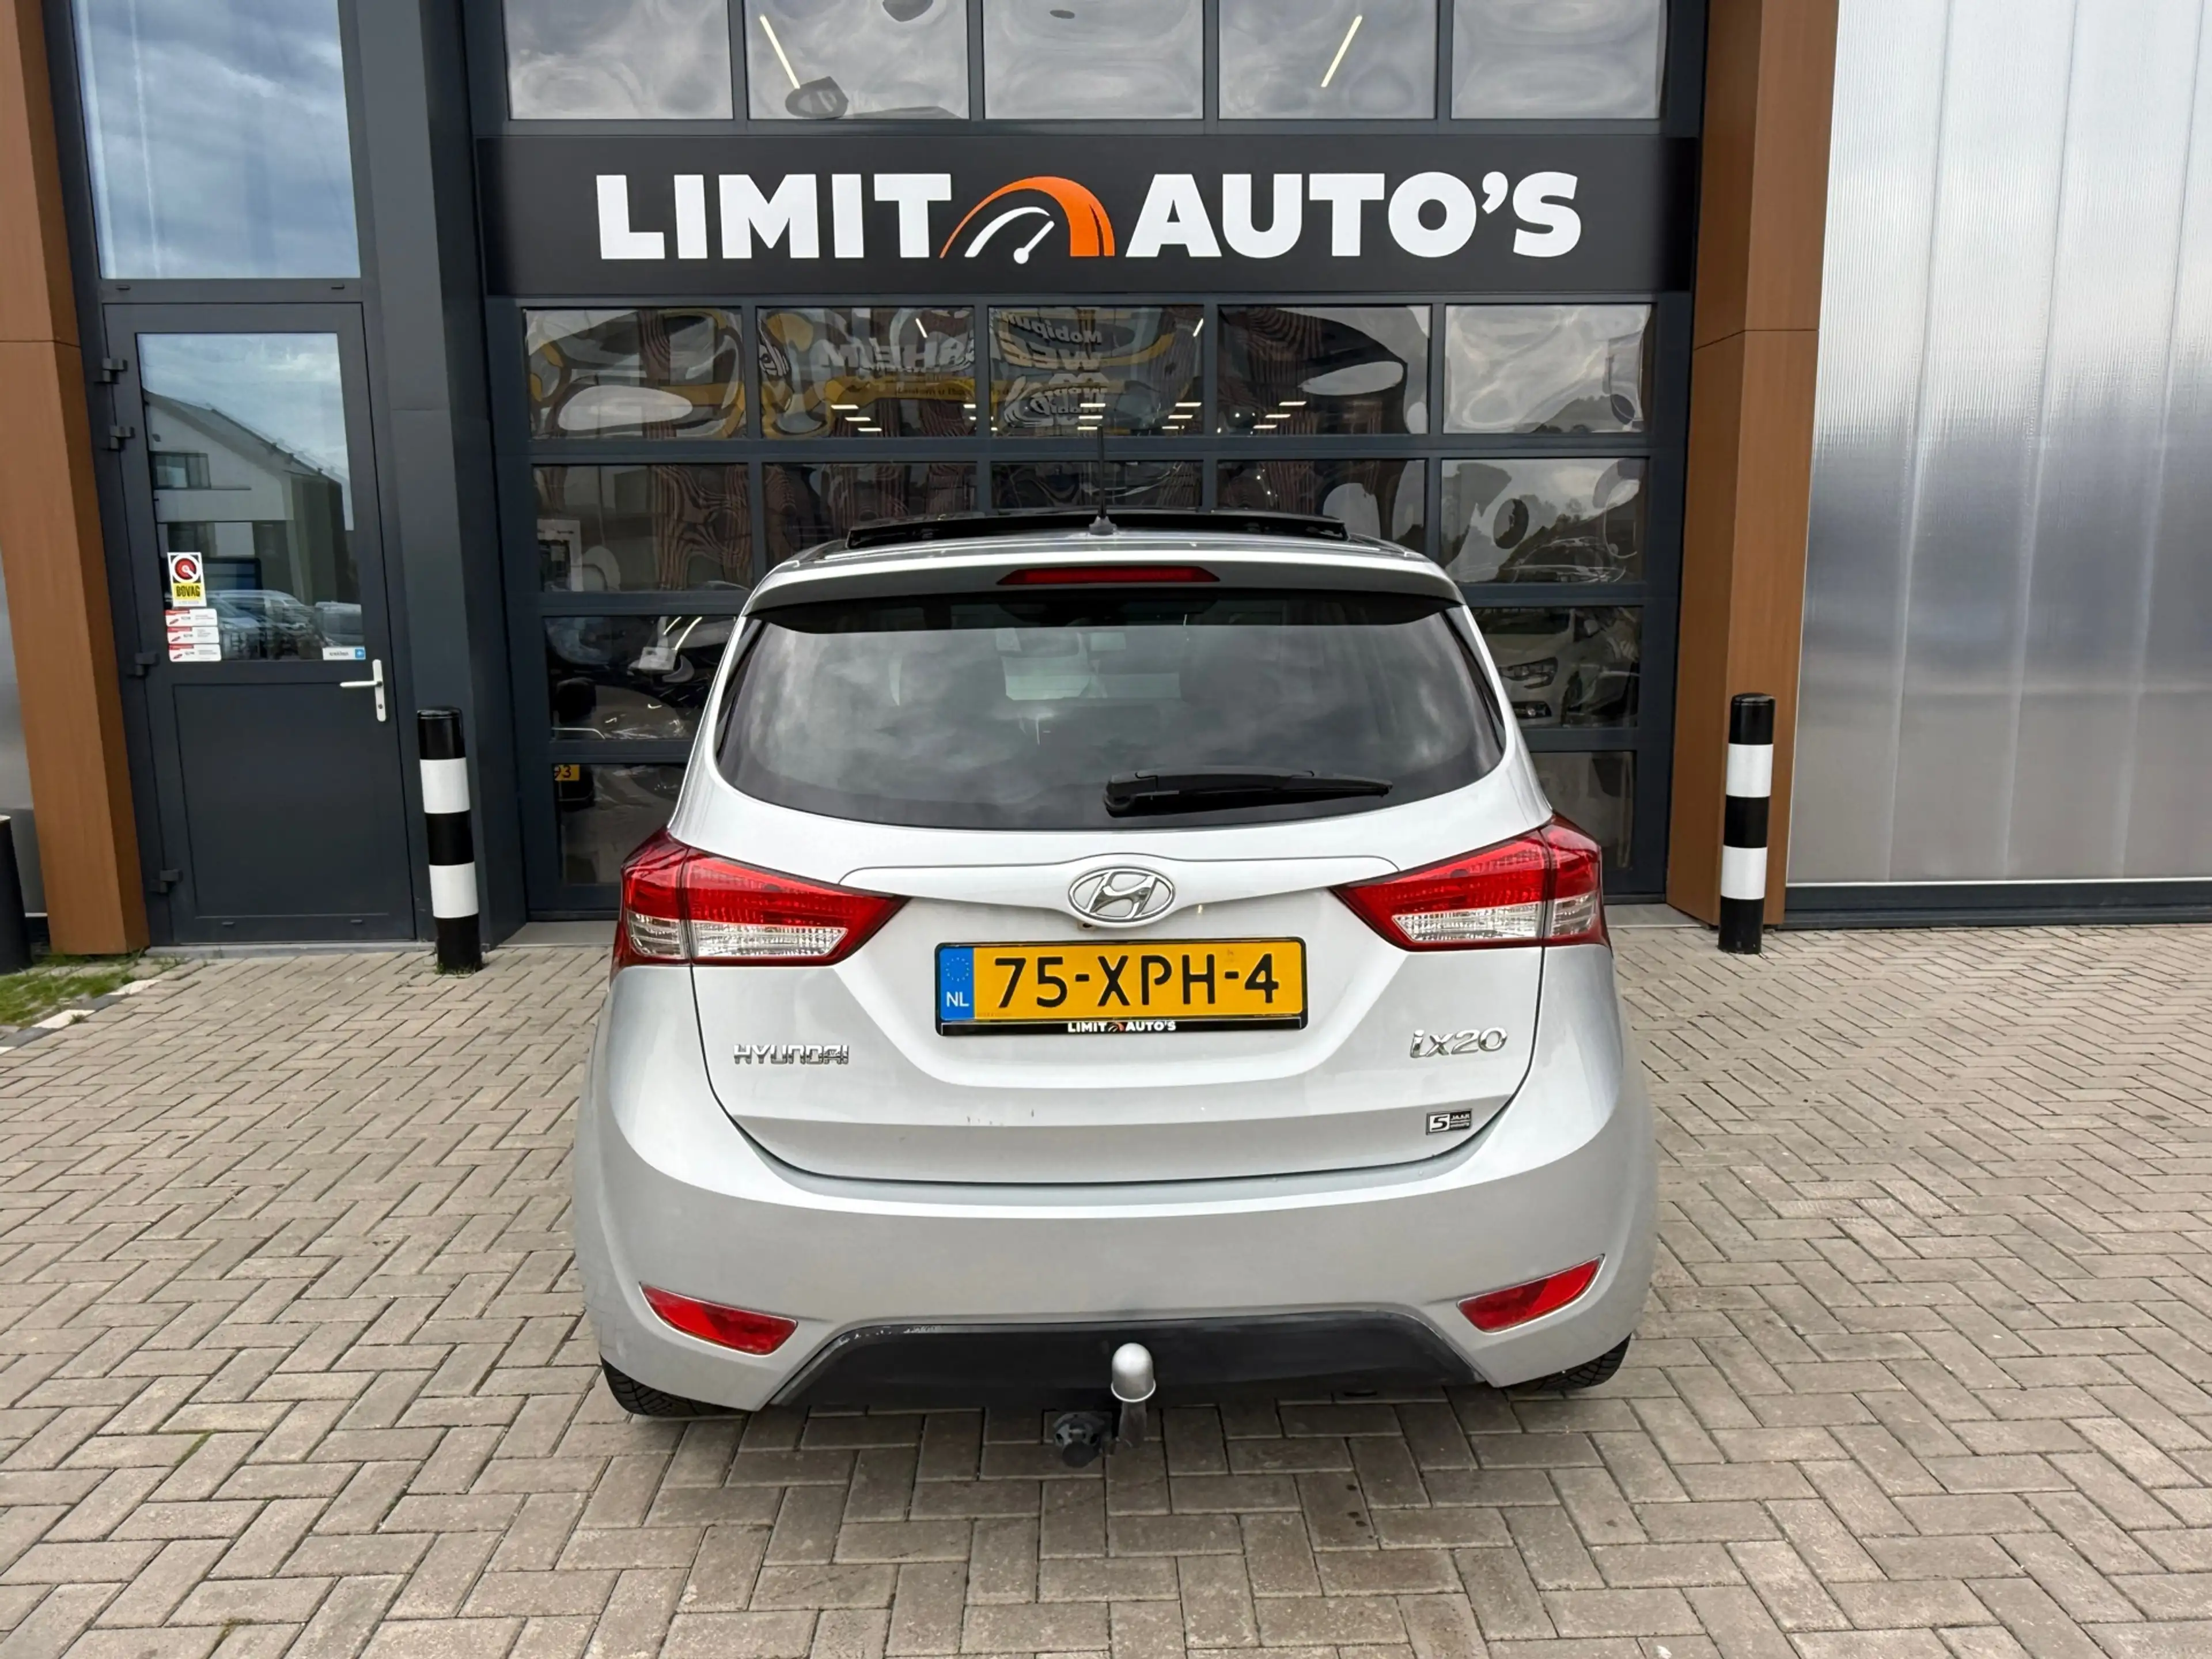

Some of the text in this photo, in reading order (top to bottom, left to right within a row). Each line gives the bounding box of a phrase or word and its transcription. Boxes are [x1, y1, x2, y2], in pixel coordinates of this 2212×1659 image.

[596, 171, 1582, 260] LIMIT AUTO'S
[995, 954, 1279, 1007] 75-XPH-4
[946, 991, 969, 1007] NL
[1067, 1020, 1176, 1033] LIMIT AUTO'S
[1410, 1027, 1508, 1058] ix20
[733, 1044, 849, 1065] HYUNDAI
[1431, 1115, 1448, 1131] 5
